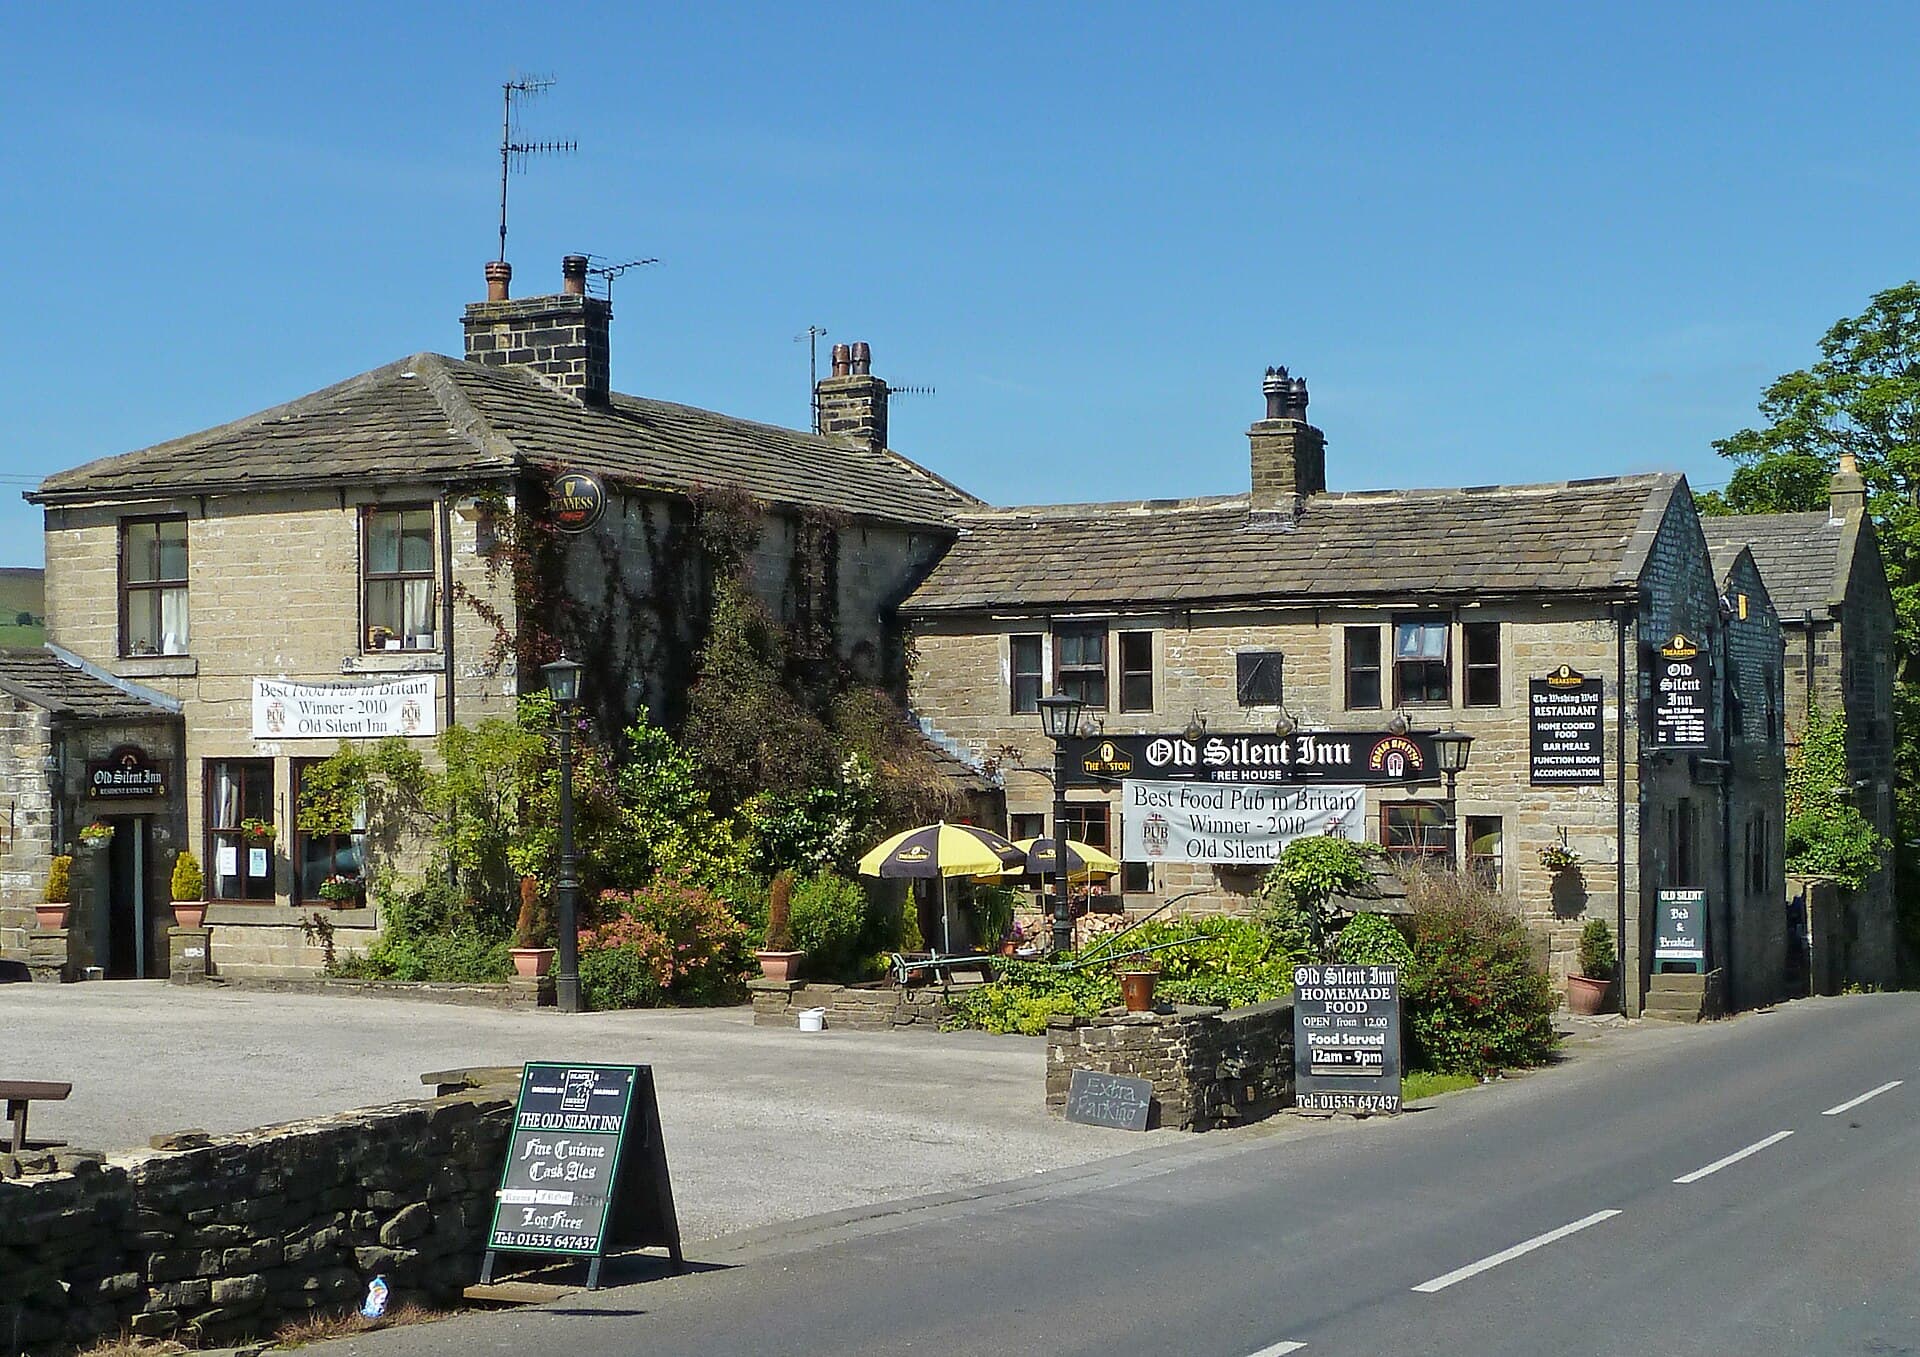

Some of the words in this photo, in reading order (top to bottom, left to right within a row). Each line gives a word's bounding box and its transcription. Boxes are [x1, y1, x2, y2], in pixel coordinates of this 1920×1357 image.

[1667, 664, 1692, 676] Old
[260, 683, 288, 697] Best
[292, 683, 326, 697] Food
[330, 684, 356, 697] Pub
[361, 684, 374, 696] in
[379, 682, 428, 696] Britain
[1660, 678, 1700, 691] Silent
[1533, 694, 1548, 703] The
[1549, 694, 1580, 704] Wishing
[1581, 694, 1598, 702] Well
[1667, 692, 1694, 706] Inn
[299, 700, 344, 714] Winner
[358, 700, 387, 714] 2010
[1534, 706, 1598, 716] RESTAURANT
[298, 719, 321, 733] Old
[326, 719, 362, 733] Silent
[367, 719, 387, 732] Inn
[1537, 722, 1560, 730] HOME
[1562, 722, 1595, 730] COOKED
[1145, 738, 1197, 767] Old
[1202, 736, 1290, 766] Silent
[1296, 736, 1352, 765] Inn
[1372, 741, 1391, 768] JOHN
[94, 770, 112, 784] Old
[113, 770, 142, 784] Silent
[144, 770, 161, 783] Inn
[1211, 770, 1238, 781] FREE
[1241, 770, 1281, 780] HOUSE
[1534, 769, 1600, 777] ACCOMMODATION
[1133, 786, 1174, 808] Best
[1180, 789, 1223, 810] Food
[1231, 790, 1265, 810] Pub
[1272, 790, 1288, 811] in
[1295, 788, 1356, 811] Britain
[1189, 814, 1251, 834] Winner
[1268, 816, 1305, 835] 2010
[1144, 827, 1168, 839] PUB
[1186, 839, 1217, 858] Old
[1224, 839, 1270, 858] Silent
[1661, 891, 1676, 900] OLD
[1677, 890, 1704, 900] SILENT
[1670, 908, 1689, 919] Bed
[1676, 922, 1684, 932] &
[1295, 967, 1320, 986] Old
[1324, 967, 1366, 986] Silent
[1370, 967, 1395, 985] Inn
[1301, 988, 1391, 1000] HOMEMADE
[1325, 1001, 1368, 1014] FOOD
[1303, 1017, 1330, 1026] OPEN
[1336, 1017, 1357, 1027] from
[1364, 1018, 1388, 1027] 12.00
[1308, 1033, 1339, 1045] Food
[1342, 1033, 1385, 1045] Served
[1312, 1050, 1342, 1063] 12am
[1354, 1051, 1382, 1066] 9pm
[1084, 1078, 1135, 1101] Extra
[1296, 1095, 1318, 1108] Tel:
[1321, 1095, 1355, 1109] 01535
[1358, 1096, 1399, 1111] 647437
[520, 1113, 541, 1128] THE
[542, 1114, 562, 1128] OLD
[563, 1114, 600, 1129] SILENT
[601, 1116, 621, 1130] INN
[520, 1138, 552, 1160] Fine
[554, 1140, 605, 1160] Cuisine
[529, 1161, 563, 1182] Cask
[564, 1161, 596, 1181] Ales
[548, 1210, 583, 1230] Fires
[494, 1232, 515, 1245] Tel:
[517, 1234, 552, 1246] 01535
[554, 1236, 598, 1249] 647437
